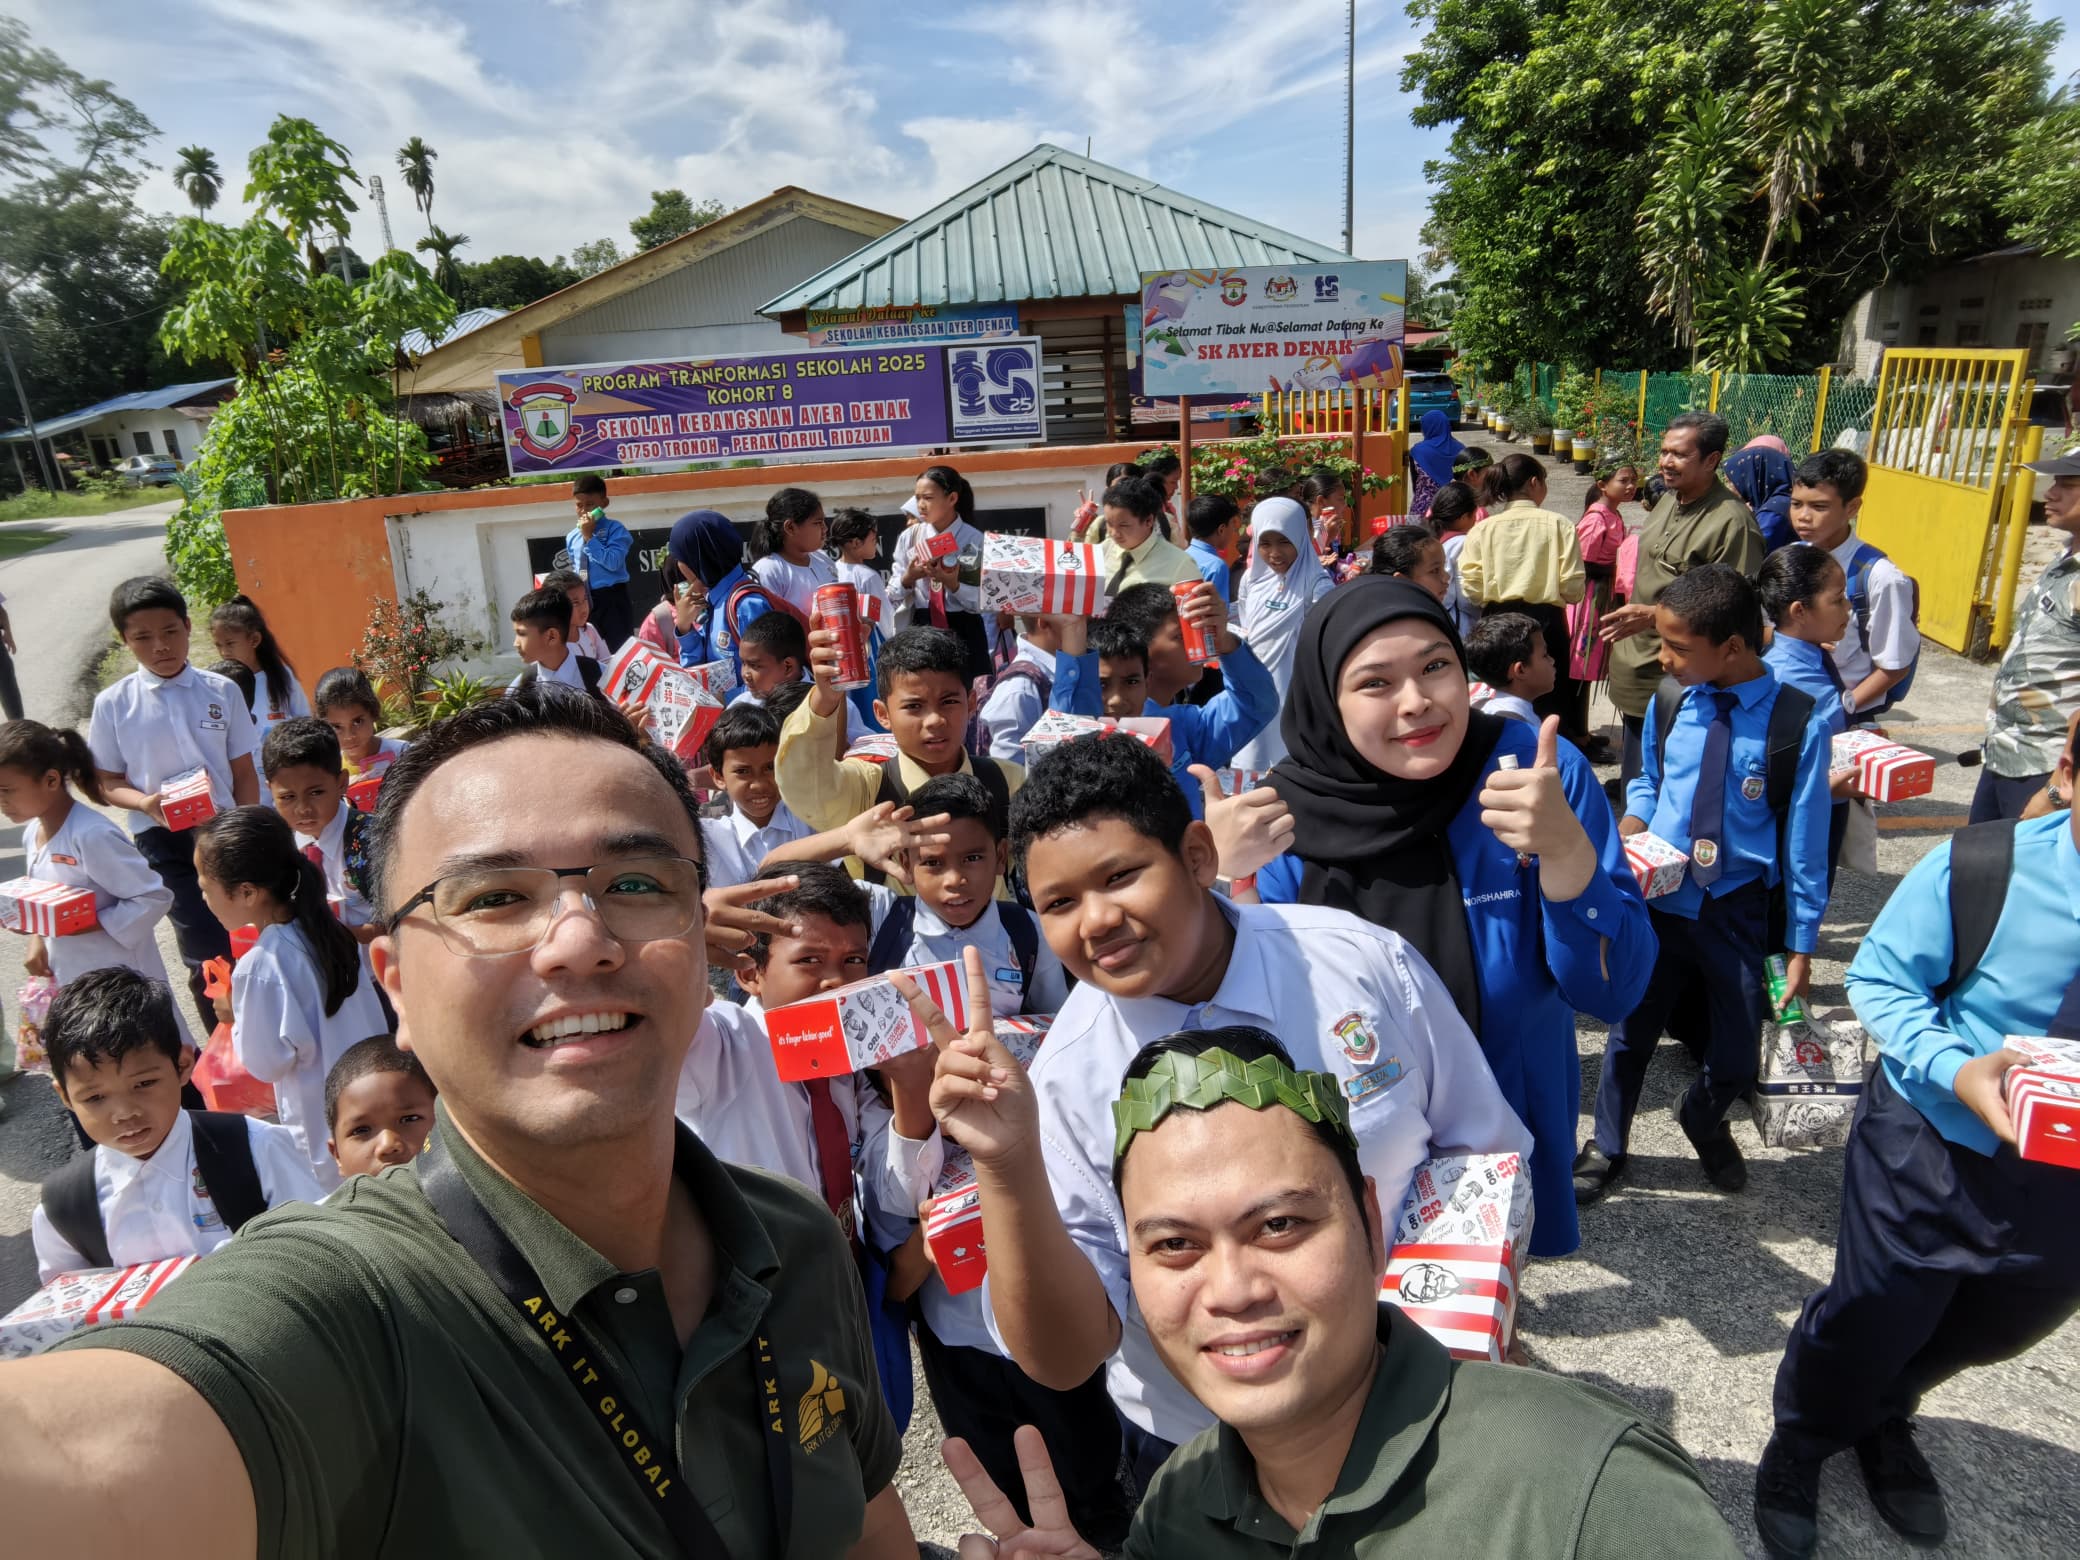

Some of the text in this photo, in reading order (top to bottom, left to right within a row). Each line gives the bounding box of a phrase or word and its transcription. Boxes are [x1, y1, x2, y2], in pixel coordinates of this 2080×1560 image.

[827, 317, 1013, 342] SEKOLAH KEBANGSAAN AYER DENAK
[1166, 318, 1384, 337] Selamat Tibak Nu@Selamat Datang Ke
[1198, 339, 1353, 360] SK AYER DENAK
[582, 353, 926, 393] PROGRAM TRANFORMASI SEKOLAH 2025
[707, 384, 793, 406] KOHORT 8
[1009, 397, 1033, 412] 25
[598, 399, 911, 440] SEKOLAH KEBANGSAAN AYER DENAK
[617, 442, 660, 460] 31750
[665, 438, 719, 458] TRONOH
[732, 433, 778, 454] PERAK
[780, 430, 827, 450] DARUL
[829, 425, 892, 446] RIDZUAN
[1463, 889, 1522, 907] NORSHAHIRA
[867, 1032, 880, 1051] ORI
[1484, 1168, 1497, 1186] ORI
[1497, 1160, 1513, 1179] 19
[1407, 1212, 1419, 1230] ORI
[1420, 1206, 1435, 1224] 19
[758, 1336, 784, 1433] ARK IT
[523, 1296, 671, 1499] ARK IT GLOBAL
[803, 1438, 820, 1456] ARK
